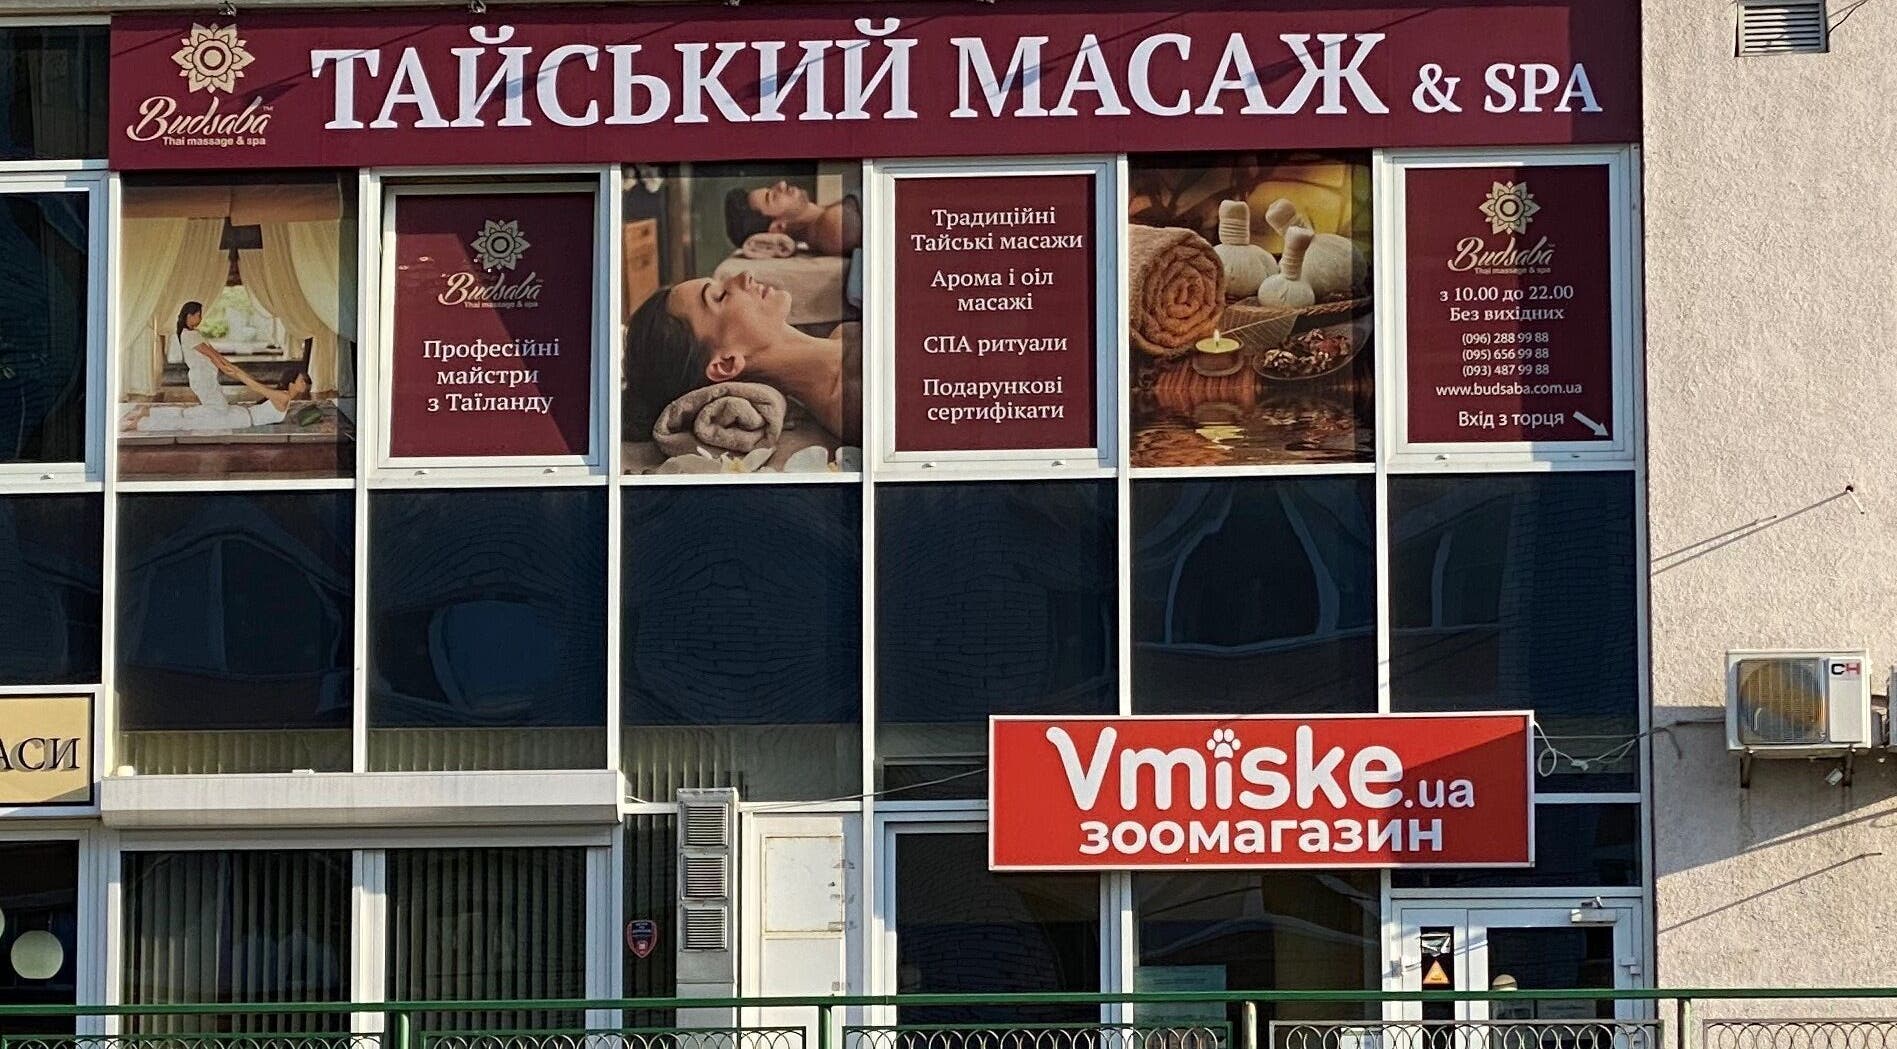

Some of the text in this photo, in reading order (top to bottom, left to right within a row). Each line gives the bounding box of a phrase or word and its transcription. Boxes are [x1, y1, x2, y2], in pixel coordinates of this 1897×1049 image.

[310, 17, 1603, 130] ТАЙСЬКИЙ МАСАЖ & SPA
[126, 95, 271, 141] Budsaba
[163, 136, 266, 148] Thai massage & spa
[931, 206, 1056, 229] Традиційні
[910, 232, 1083, 252] Тайські масажи
[1447, 235, 1554, 272] Budsaba
[438, 271, 542, 306] Budsaba
[930, 269, 1002, 290] Арома
[1021, 267, 1054, 286] оіл
[957, 292, 1033, 312] масажі
[1439, 285, 1574, 303] з 10.00 до 22.00
[1450, 306, 1564, 322] Без вихідних
[923, 336, 1067, 356] СПА ритуали
[1462, 332, 1549, 345] (096) 288 99 88
[423, 337, 559, 363] Професійні
[1462, 348, 1549, 361] (095) 656 99 88
[436, 365, 540, 388] майстри
[1462, 364, 1549, 377] (093) 487 99 88
[923, 377, 1063, 398] Подарункові
[1435, 381, 1582, 397] www.budsaba.com.ua
[427, 393, 554, 414] з Таїланду
[927, 402, 1064, 424] сертифікати
[1458, 411, 1564, 428] Вхід з торця
[1046, 725, 1475, 811] Vmiske.ua
[1079, 817, 1443, 855] зоомагазин
